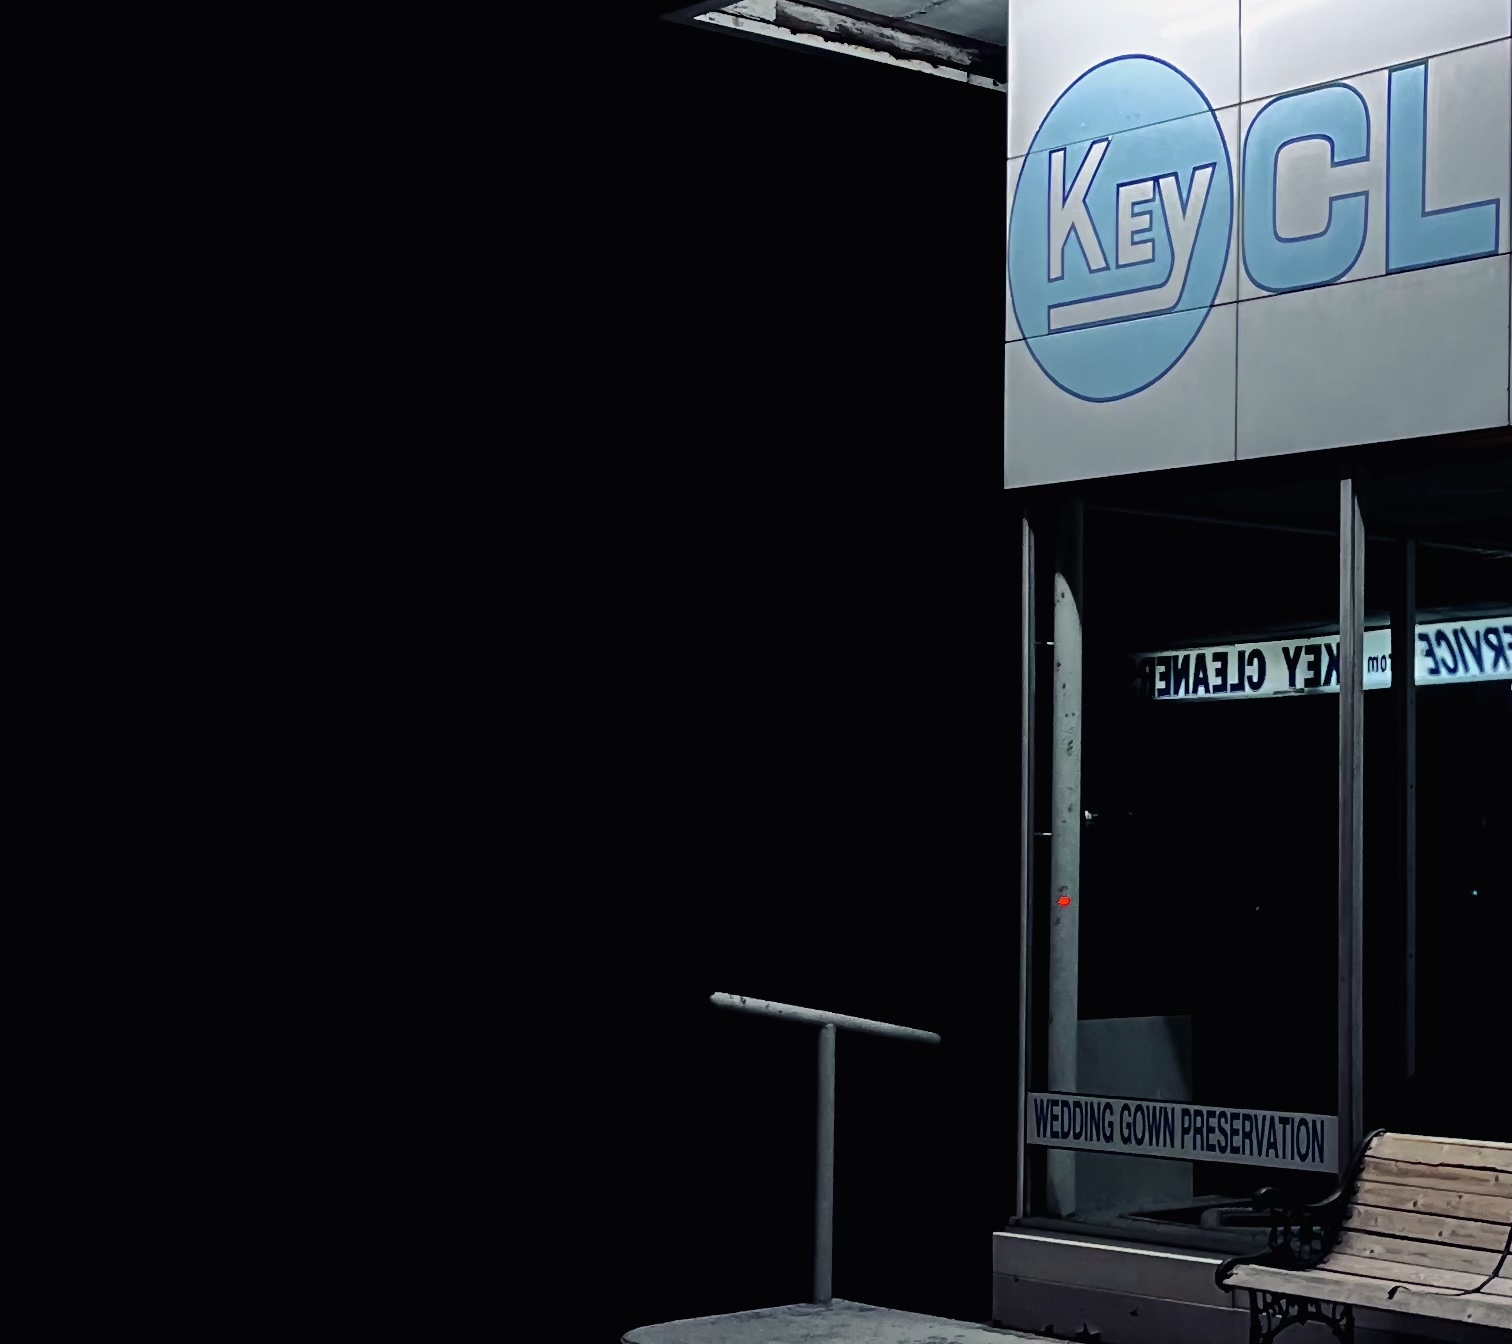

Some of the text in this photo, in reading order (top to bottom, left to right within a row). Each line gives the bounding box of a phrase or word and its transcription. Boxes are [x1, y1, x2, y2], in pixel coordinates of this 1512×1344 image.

[1034, 1097, 1325, 1164] WEDDING GOWN PRESERVATION
